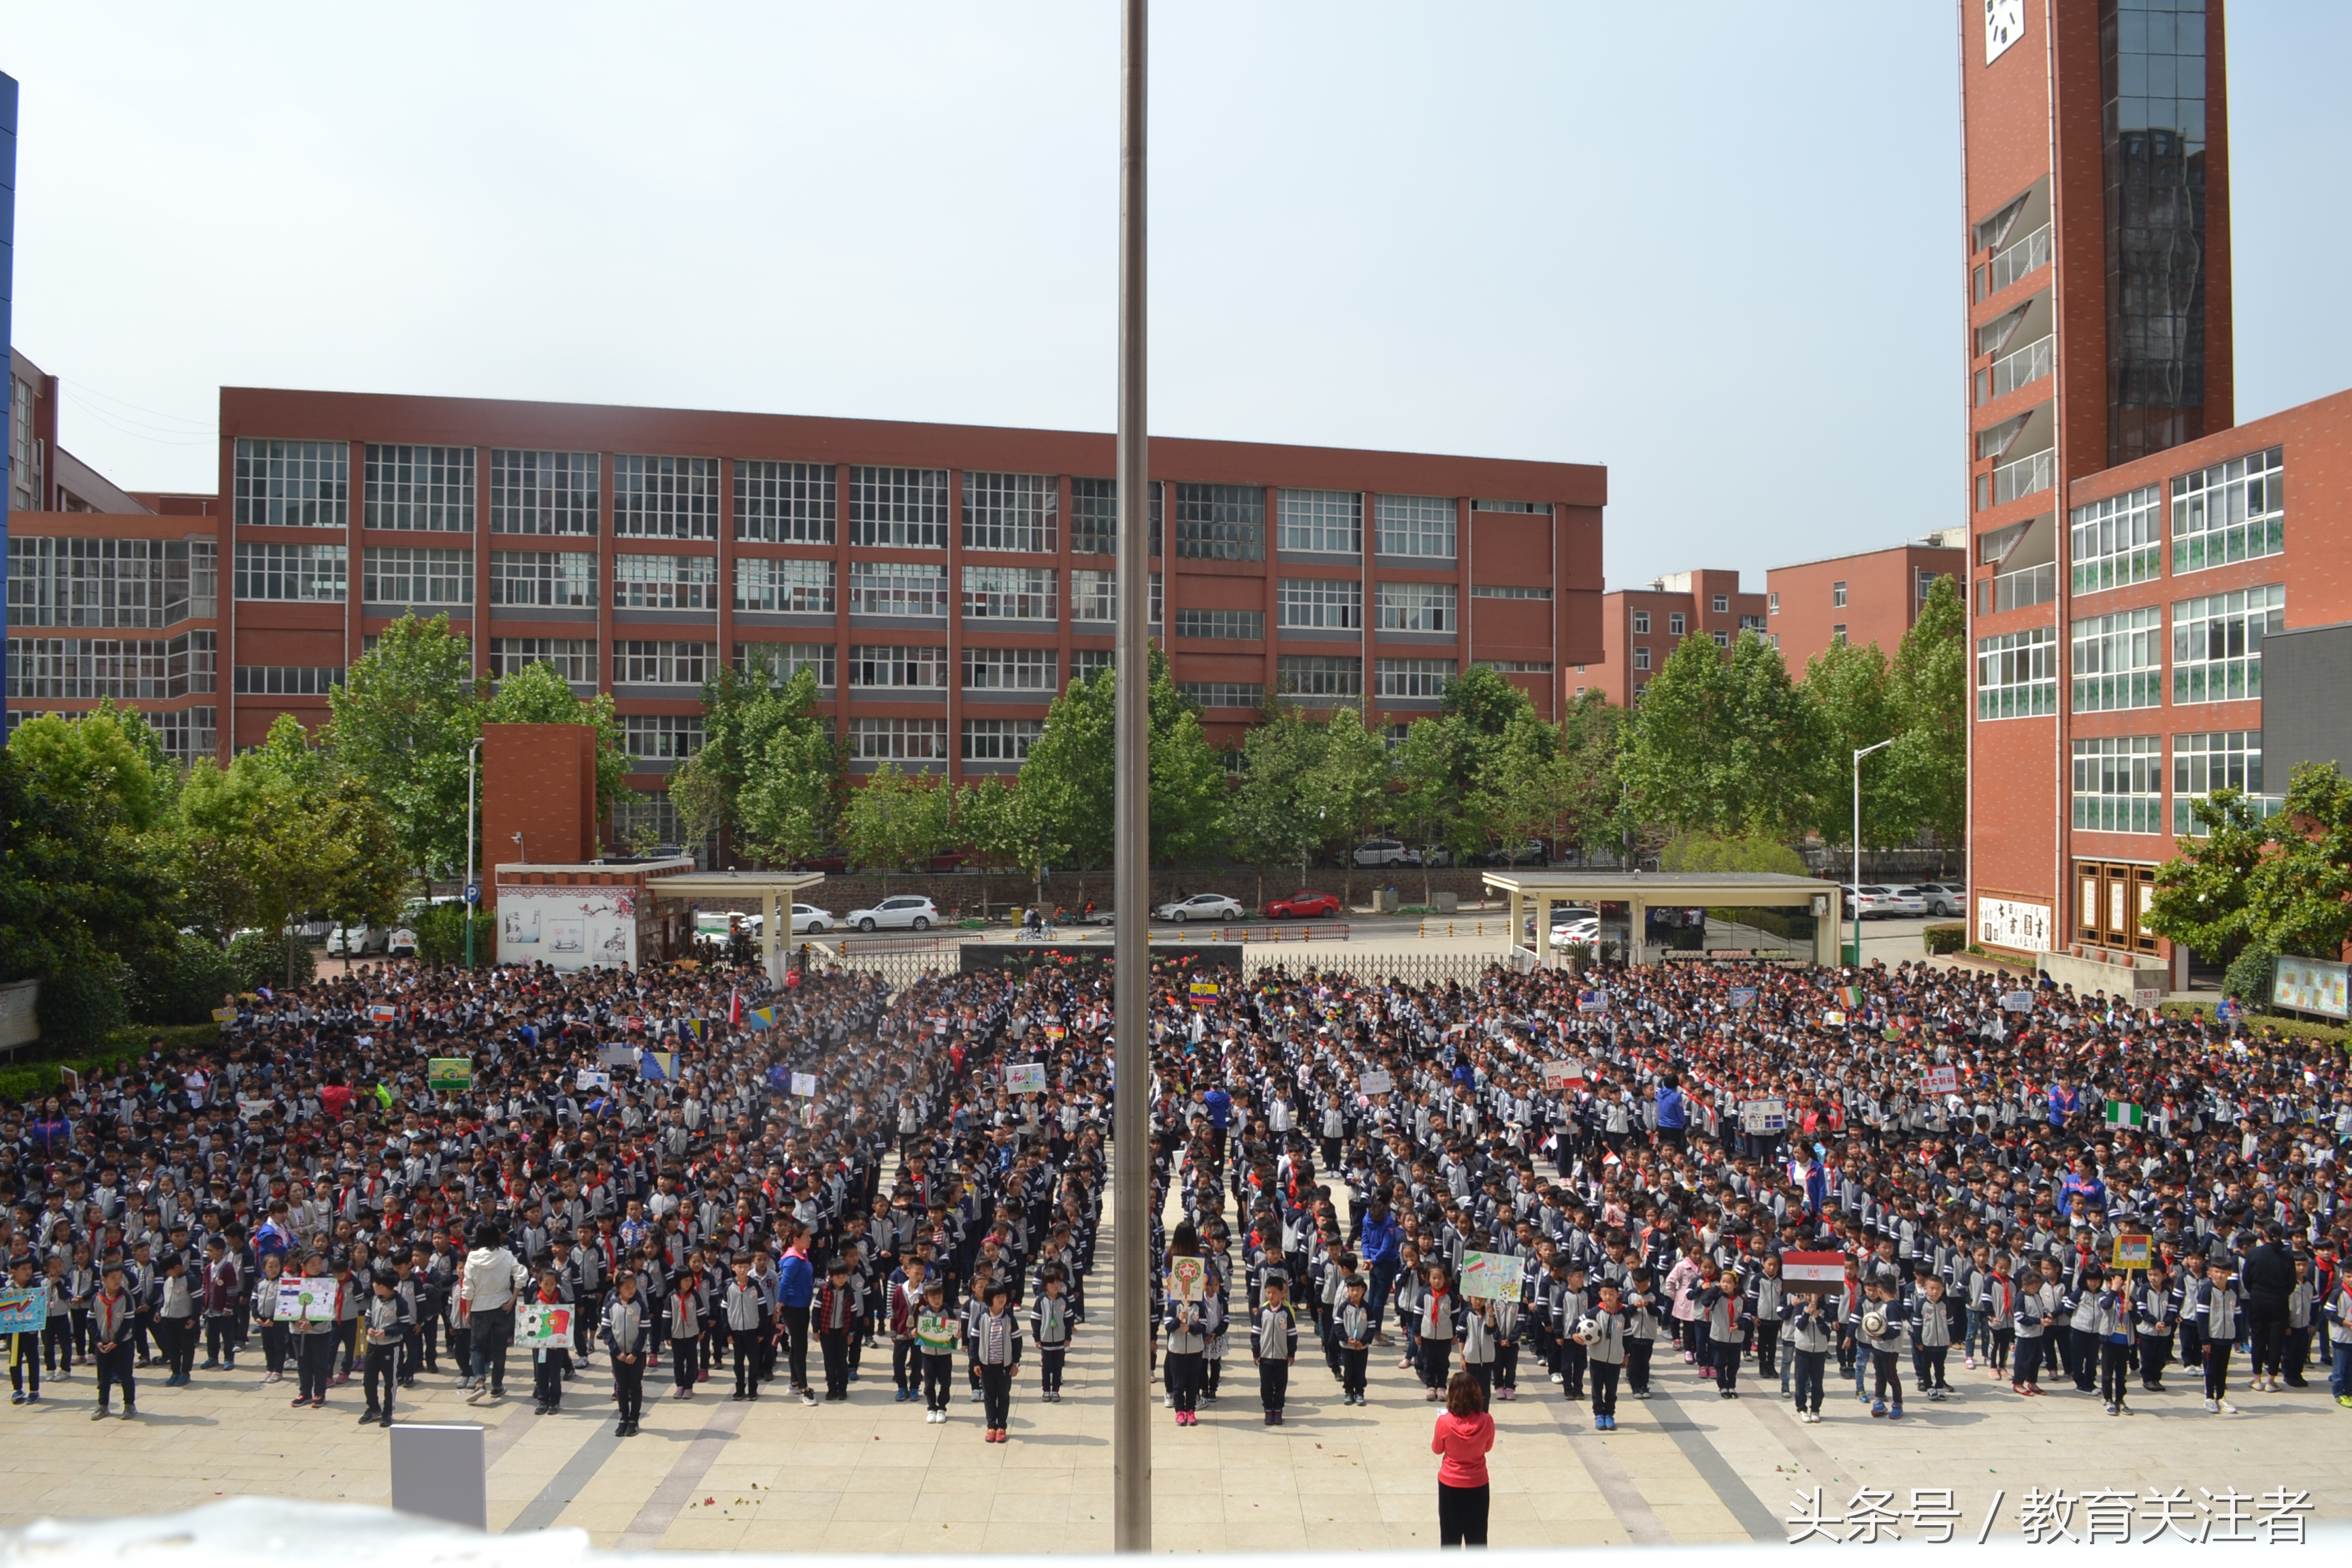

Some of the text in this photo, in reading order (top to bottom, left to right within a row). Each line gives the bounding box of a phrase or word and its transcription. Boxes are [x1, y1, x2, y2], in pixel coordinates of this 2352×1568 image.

[1987, 0, 1993, 13] 9
[2001, 27, 2007, 44] 6
[468, 887, 477, 900] P
[1923, 1076, 1955, 1088] 意大利队
[920, 1319, 958, 1337] 墨西哥
